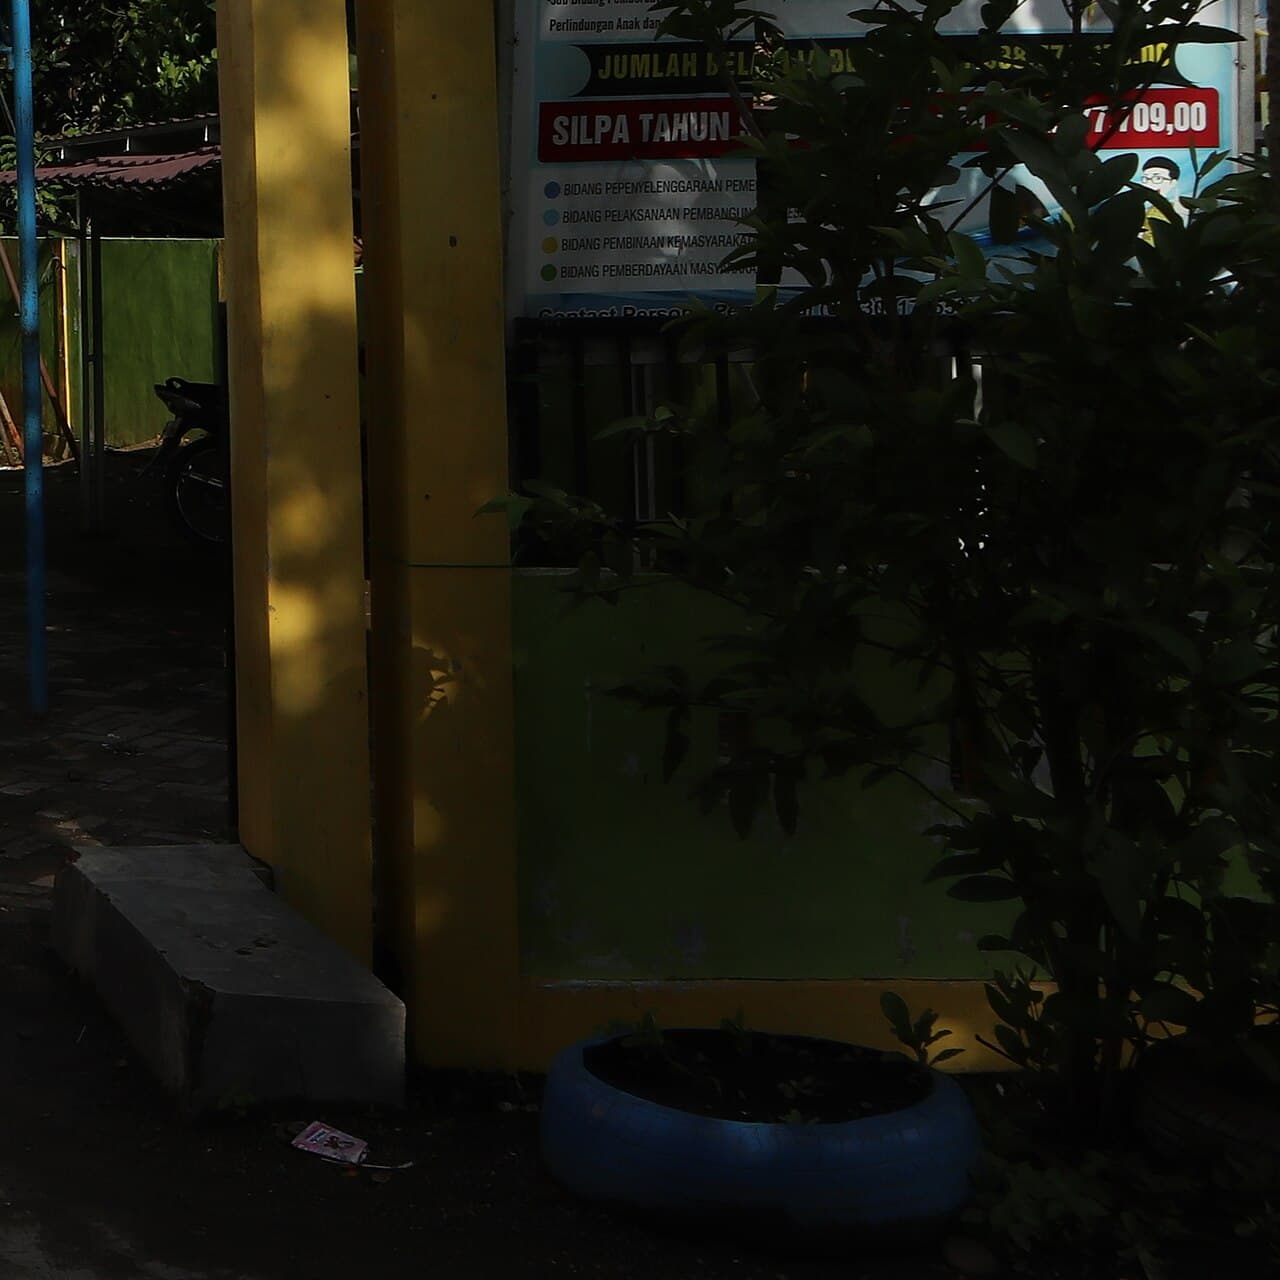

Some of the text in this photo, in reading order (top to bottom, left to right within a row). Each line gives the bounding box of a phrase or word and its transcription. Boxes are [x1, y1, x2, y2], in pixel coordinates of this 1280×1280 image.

[550, 19, 614, 33] Perlindungan
[616, 18, 640, 31] Anak
[597, 50, 698, 80] JUMLAH
[552, 111, 730, 146] SILPA TAHUN
[564, 182, 602, 196] BIDANG
[605, 179, 723, 194] PEPENYELENGGARAAN
[563, 210, 601, 224] BIDANG
[605, 208, 680, 222] PELAKSANAAN
[562, 236, 664, 251] BIDANG PEMBINAAN
[561, 265, 599, 279] BIDANG
[602, 263, 688, 277] PEMBERDAYAAN
